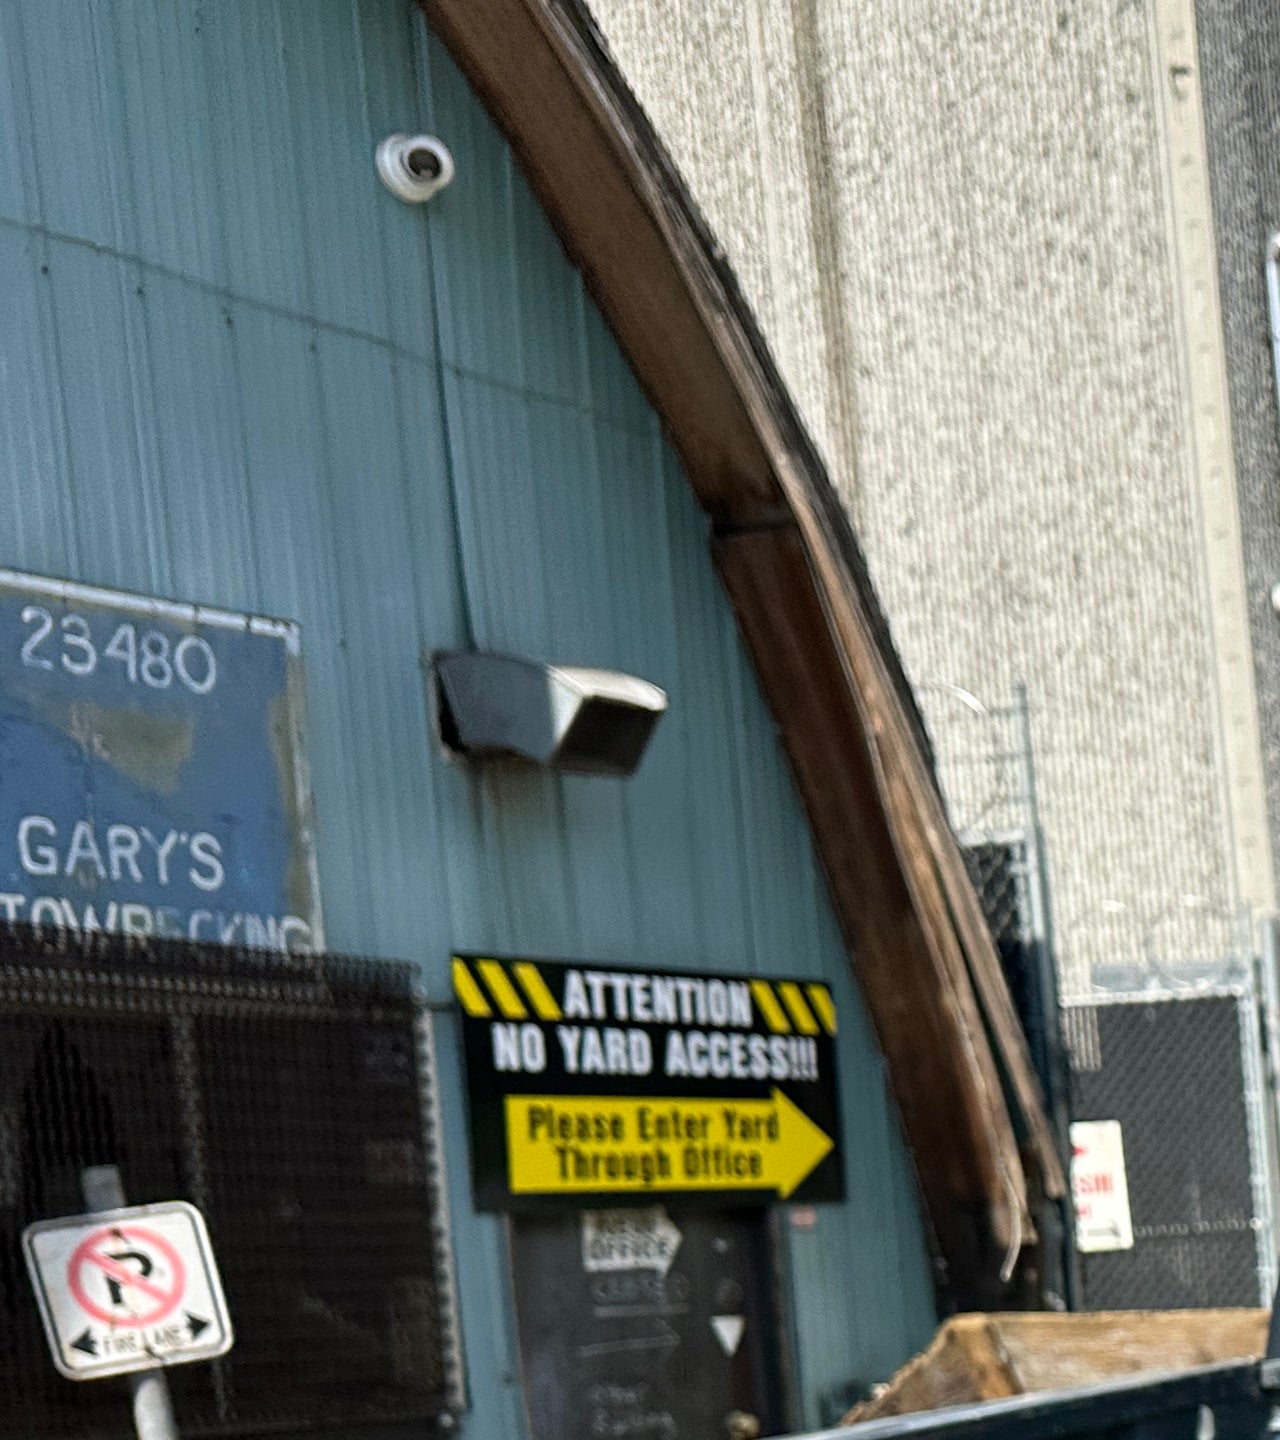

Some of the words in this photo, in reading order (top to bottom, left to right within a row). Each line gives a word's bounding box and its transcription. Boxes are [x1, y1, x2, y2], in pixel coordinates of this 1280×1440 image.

[20, 604, 216, 695] 23480
[17, 814, 225, 892] GARY'S
[563, 968, 753, 1029] ATTENTION
[490, 1021, 547, 1074] NO
[556, 1024, 654, 1077] YARD
[664, 1028, 819, 1082] ACCESS!!!
[528, 1103, 624, 1142] Please
[637, 1105, 710, 1143] Enter
[722, 1106, 780, 1143] Yard
[555, 1143, 672, 1184] Through
[682, 1141, 763, 1179] Office
